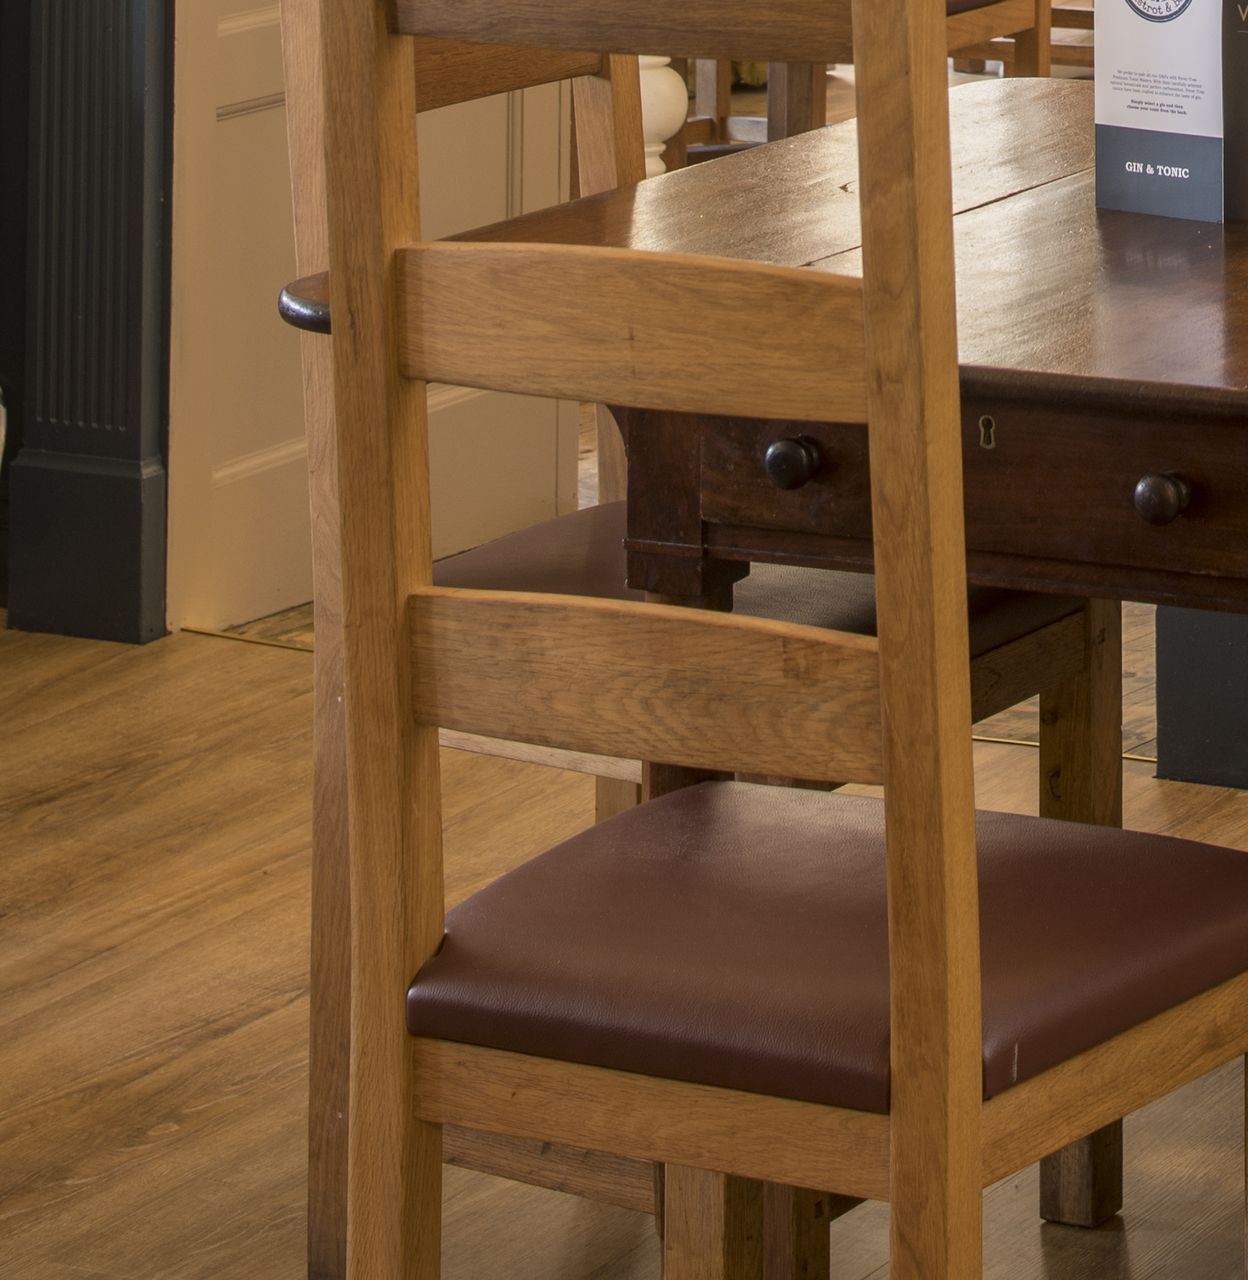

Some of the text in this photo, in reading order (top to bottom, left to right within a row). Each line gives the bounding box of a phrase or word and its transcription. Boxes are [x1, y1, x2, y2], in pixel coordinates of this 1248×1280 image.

[1165, 2, 1173, 13] &
[1125, 161, 1190, 179] GIN & TONIC
